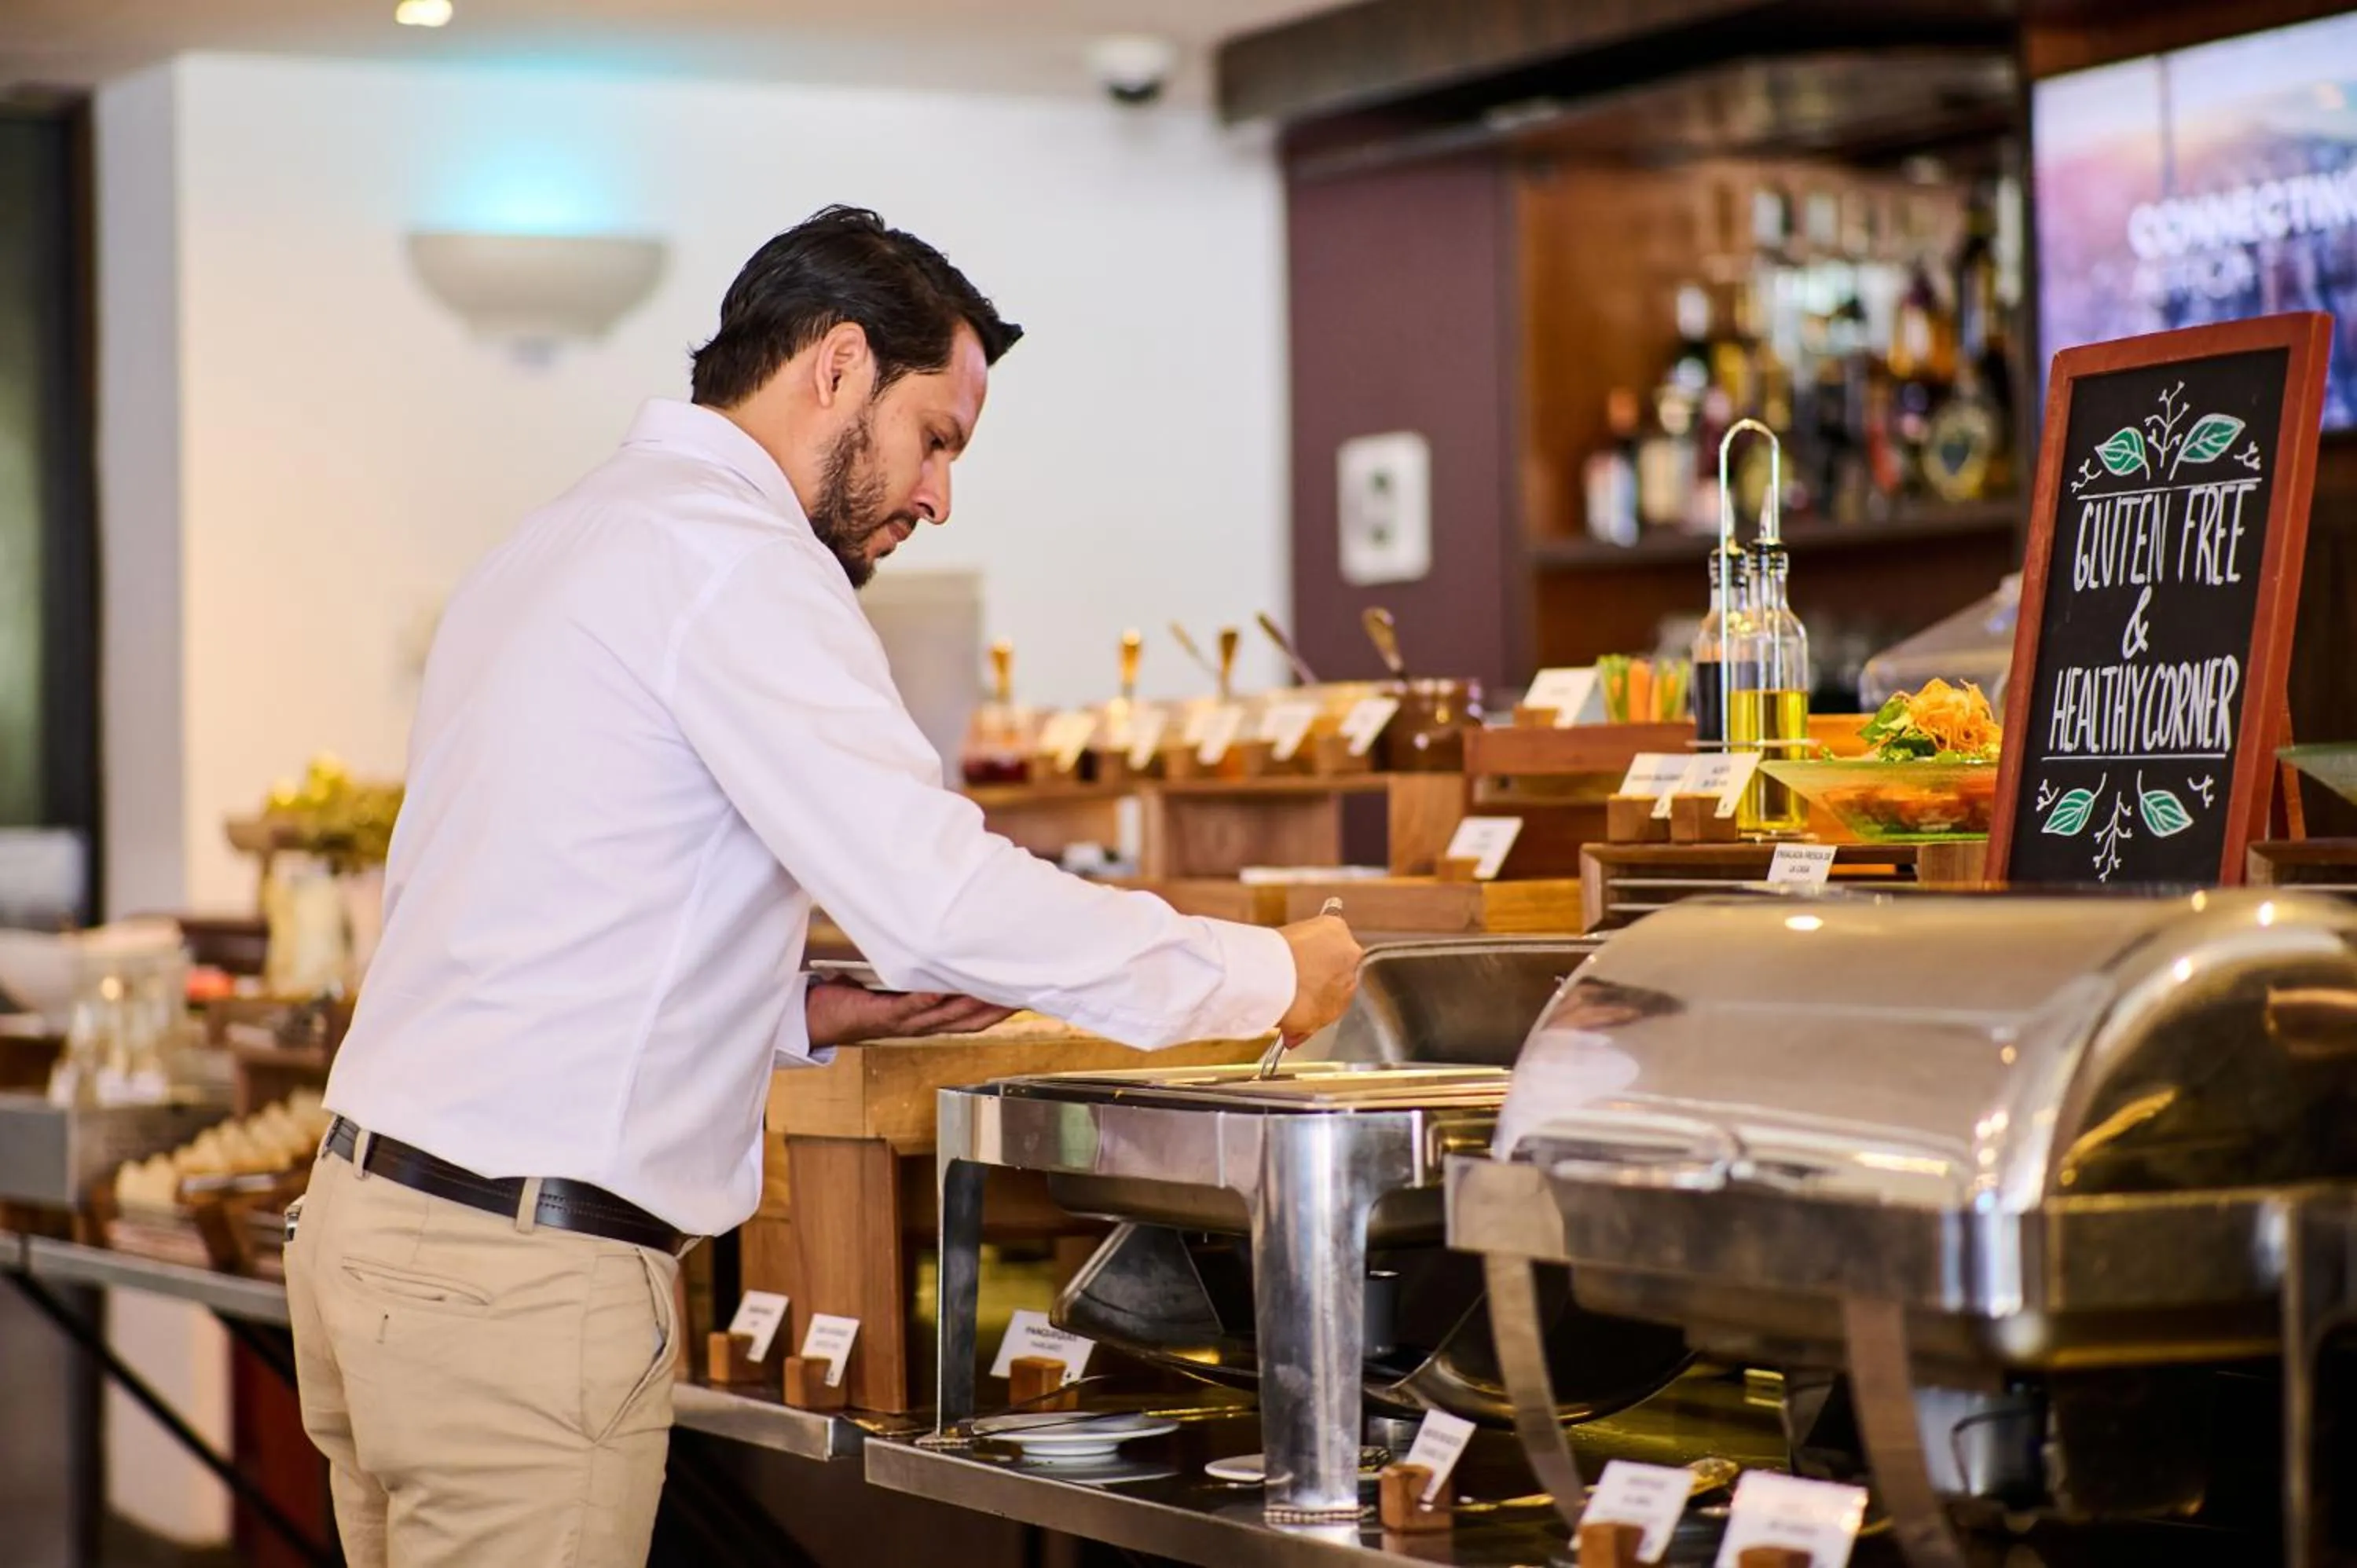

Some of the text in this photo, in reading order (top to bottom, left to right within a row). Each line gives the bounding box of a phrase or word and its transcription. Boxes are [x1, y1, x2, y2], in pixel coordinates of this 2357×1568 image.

[2073, 483, 2257, 592] GLUTEN FREE
[2123, 585, 2152, 659] &
[2049, 654, 2239, 754] HEALTHY CORNER
